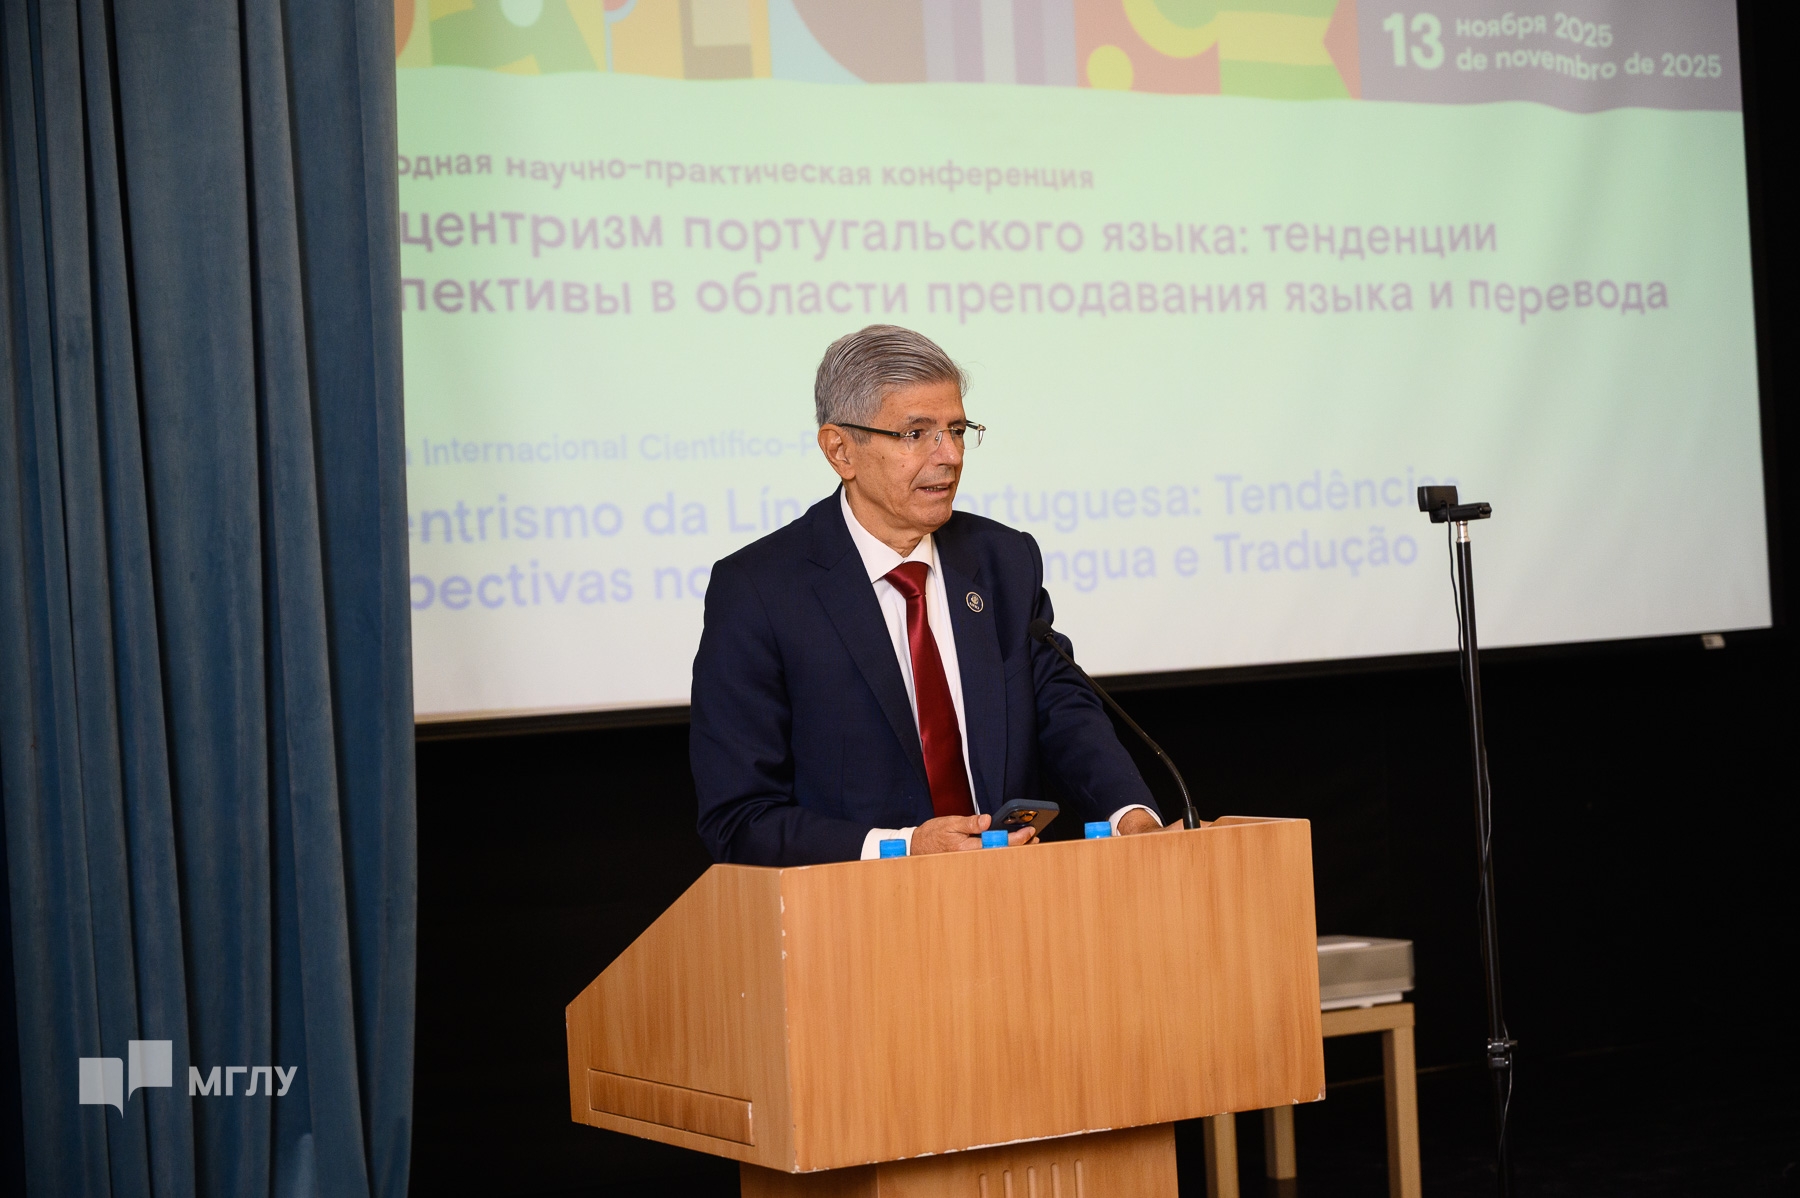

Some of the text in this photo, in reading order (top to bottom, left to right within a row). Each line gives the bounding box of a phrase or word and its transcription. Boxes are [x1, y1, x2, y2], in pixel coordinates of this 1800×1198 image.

[1382, 12, 1445, 70] 13
[1456, 12, 1613, 48] ноября 2025
[1456, 48, 1722, 80] de novembro de 2025
[505, 156, 871, 190] научно-практическая
[881, 159, 1094, 194] конференция
[400, 211, 1497, 264] центризм португальского языка: тенденции
[401, 271, 1669, 326] пективы в области преподавания языка и перевода
[423, 433, 628, 466] Internacional
[643, 490, 708, 536] da
[1175, 545, 1199, 577] e
[1213, 525, 1419, 577] Tradução
